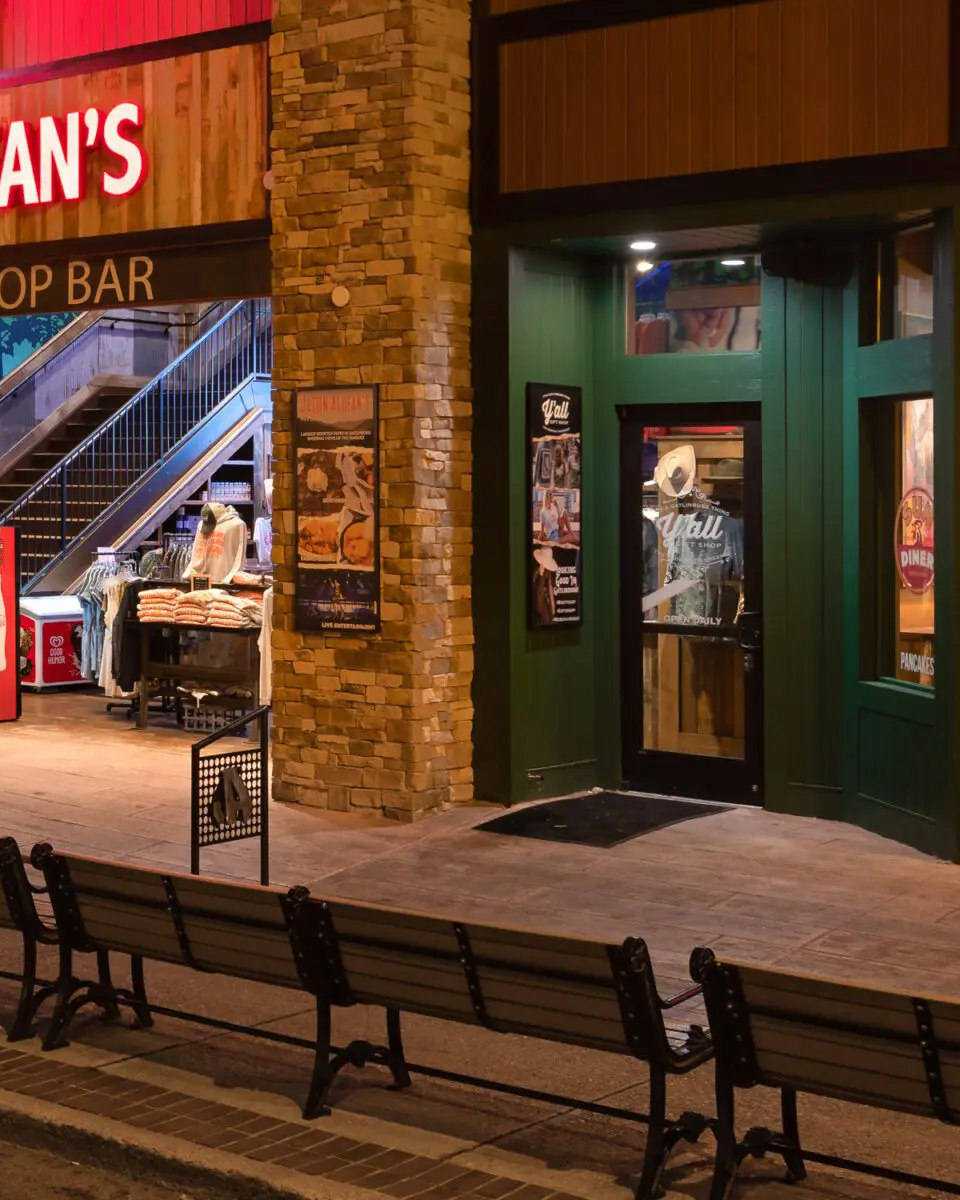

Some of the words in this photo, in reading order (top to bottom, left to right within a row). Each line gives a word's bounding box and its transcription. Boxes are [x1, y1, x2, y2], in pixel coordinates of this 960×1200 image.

[67, 255, 155, 306] BAR
[542, 399, 570, 426] Y'all
[656, 511, 725, 549] Y'all
[900, 550, 934, 570] DINER
[663, 614, 690, 625] OPEN
[694, 615, 723, 626] DAILY
[49, 647, 64, 657] GOOD
[900, 651, 935, 677] PANCAKES
